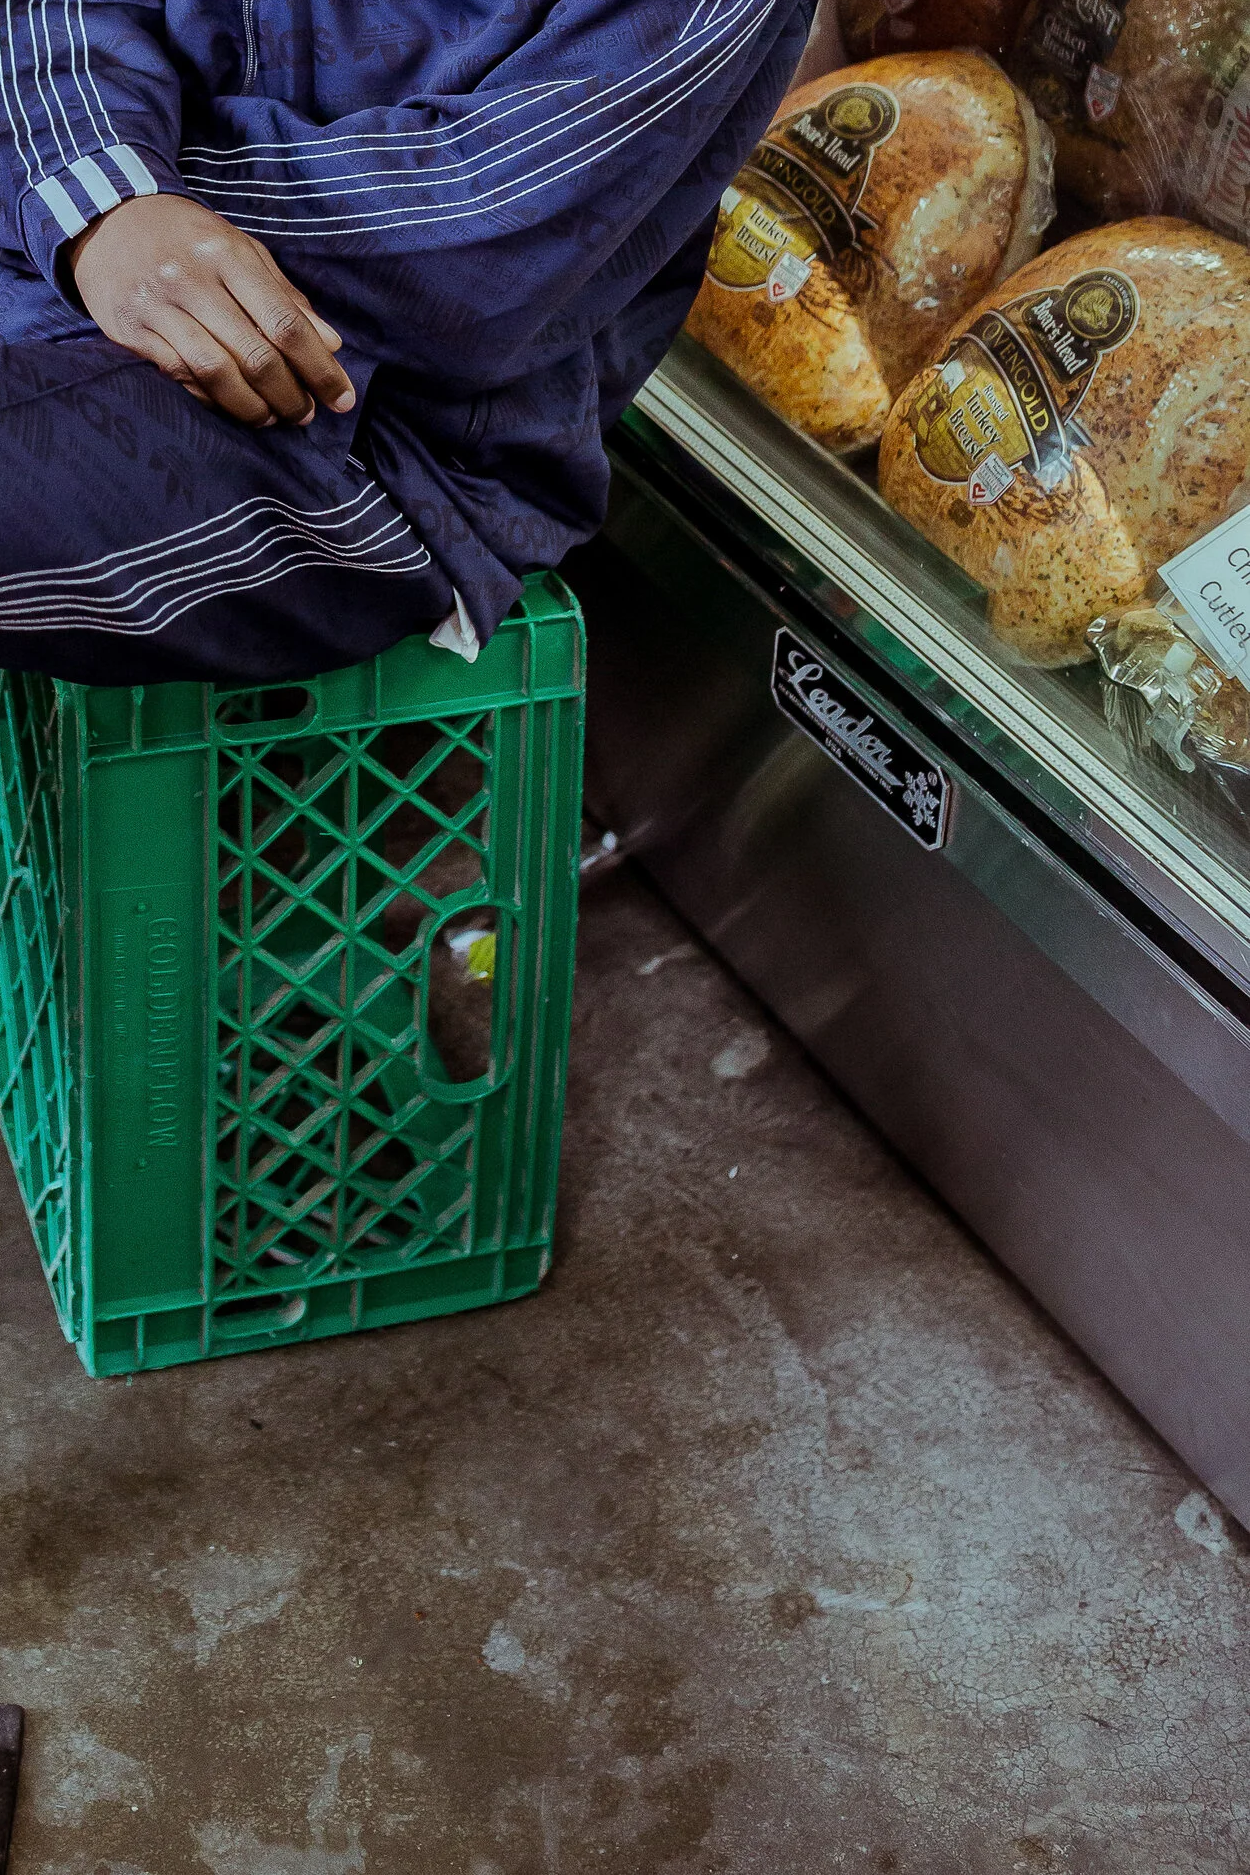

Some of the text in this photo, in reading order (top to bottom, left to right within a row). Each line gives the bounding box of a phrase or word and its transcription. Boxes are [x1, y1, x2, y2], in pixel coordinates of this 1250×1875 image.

[792, 112, 861, 172] Boar's Head
[734, 225, 777, 267] Breast
[747, 204, 793, 250] Turkey
[1031, 296, 1088, 375] Boar's Head
[981, 320, 1050, 434] OVENGOLD
[982, 383, 1010, 423] Roasted
[948, 407, 987, 463] Breast
[964, 386, 1002, 447] Turkey
[777, 649, 894, 767] Leader
[824, 737, 843, 759] USA
[146, 916, 179, 1150] GOLDENFLOW
